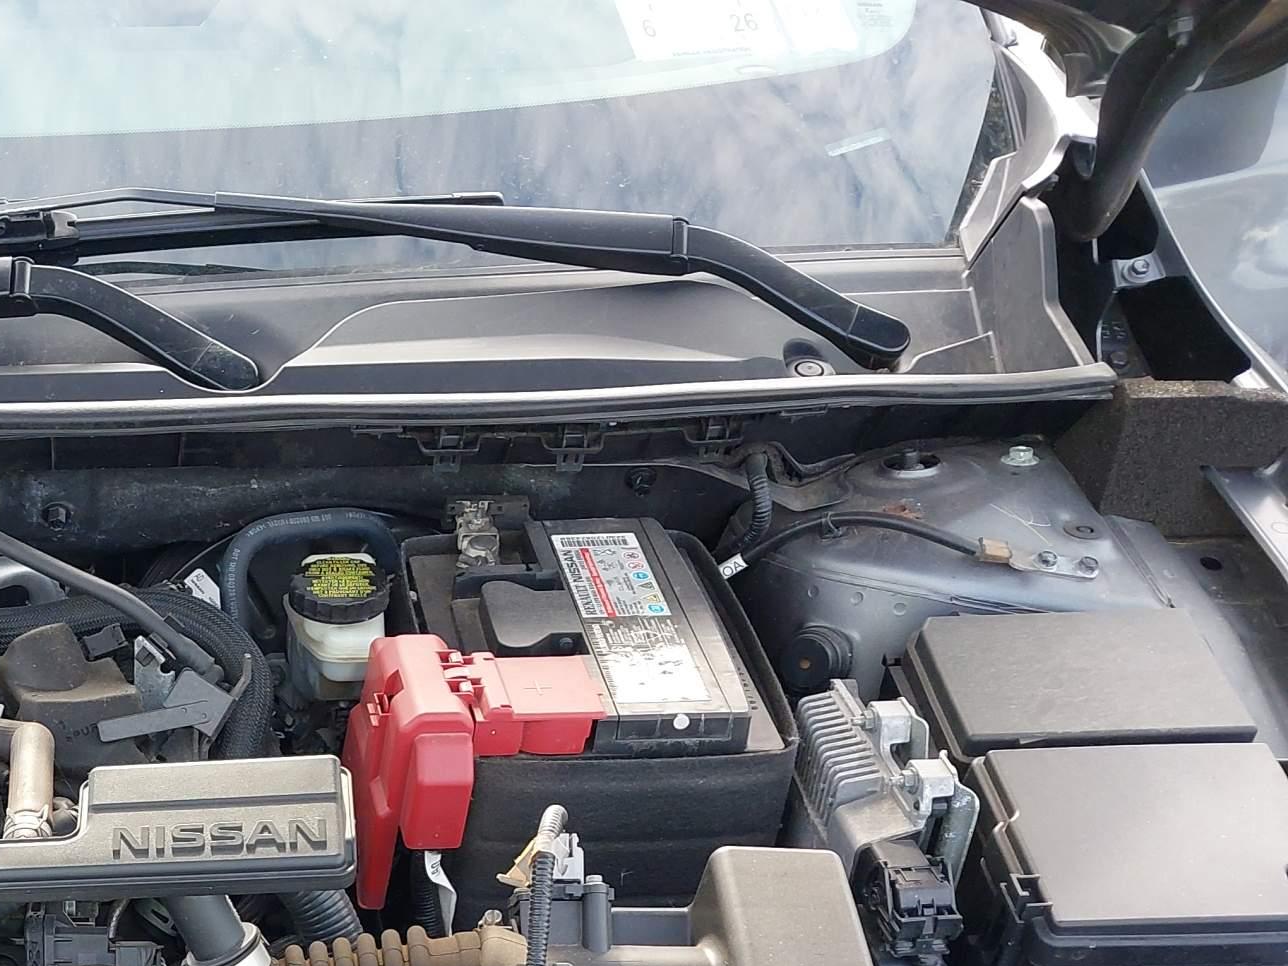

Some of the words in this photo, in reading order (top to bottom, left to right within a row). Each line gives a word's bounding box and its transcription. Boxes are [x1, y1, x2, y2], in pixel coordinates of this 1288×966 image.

[642, 17, 657, 38] 6
[729, 12, 759, 33] 26
[561, 549, 583, 583] NISSAN
[111, 817, 328, 860] NISSAN
